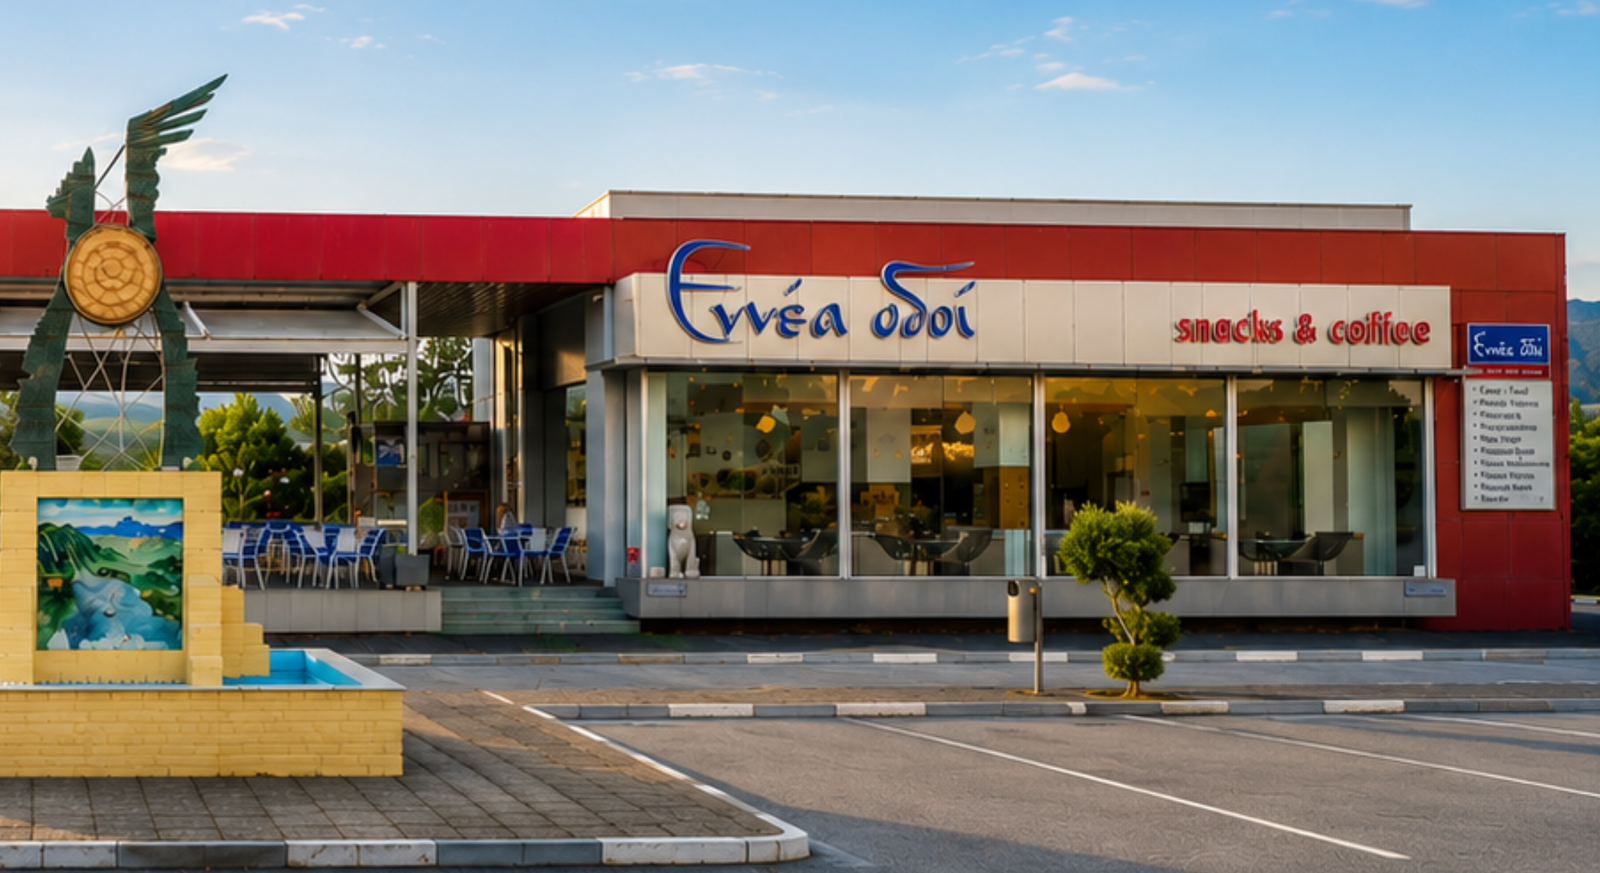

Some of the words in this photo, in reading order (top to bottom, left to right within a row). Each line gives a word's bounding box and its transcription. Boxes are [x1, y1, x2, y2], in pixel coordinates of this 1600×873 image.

[667, 239, 848, 343] Εννέα
[871, 261, 976, 339] οδοί
[1175, 309, 1284, 344] snacks
[1293, 313, 1317, 344] &
[1328, 311, 1431, 345] coffee
